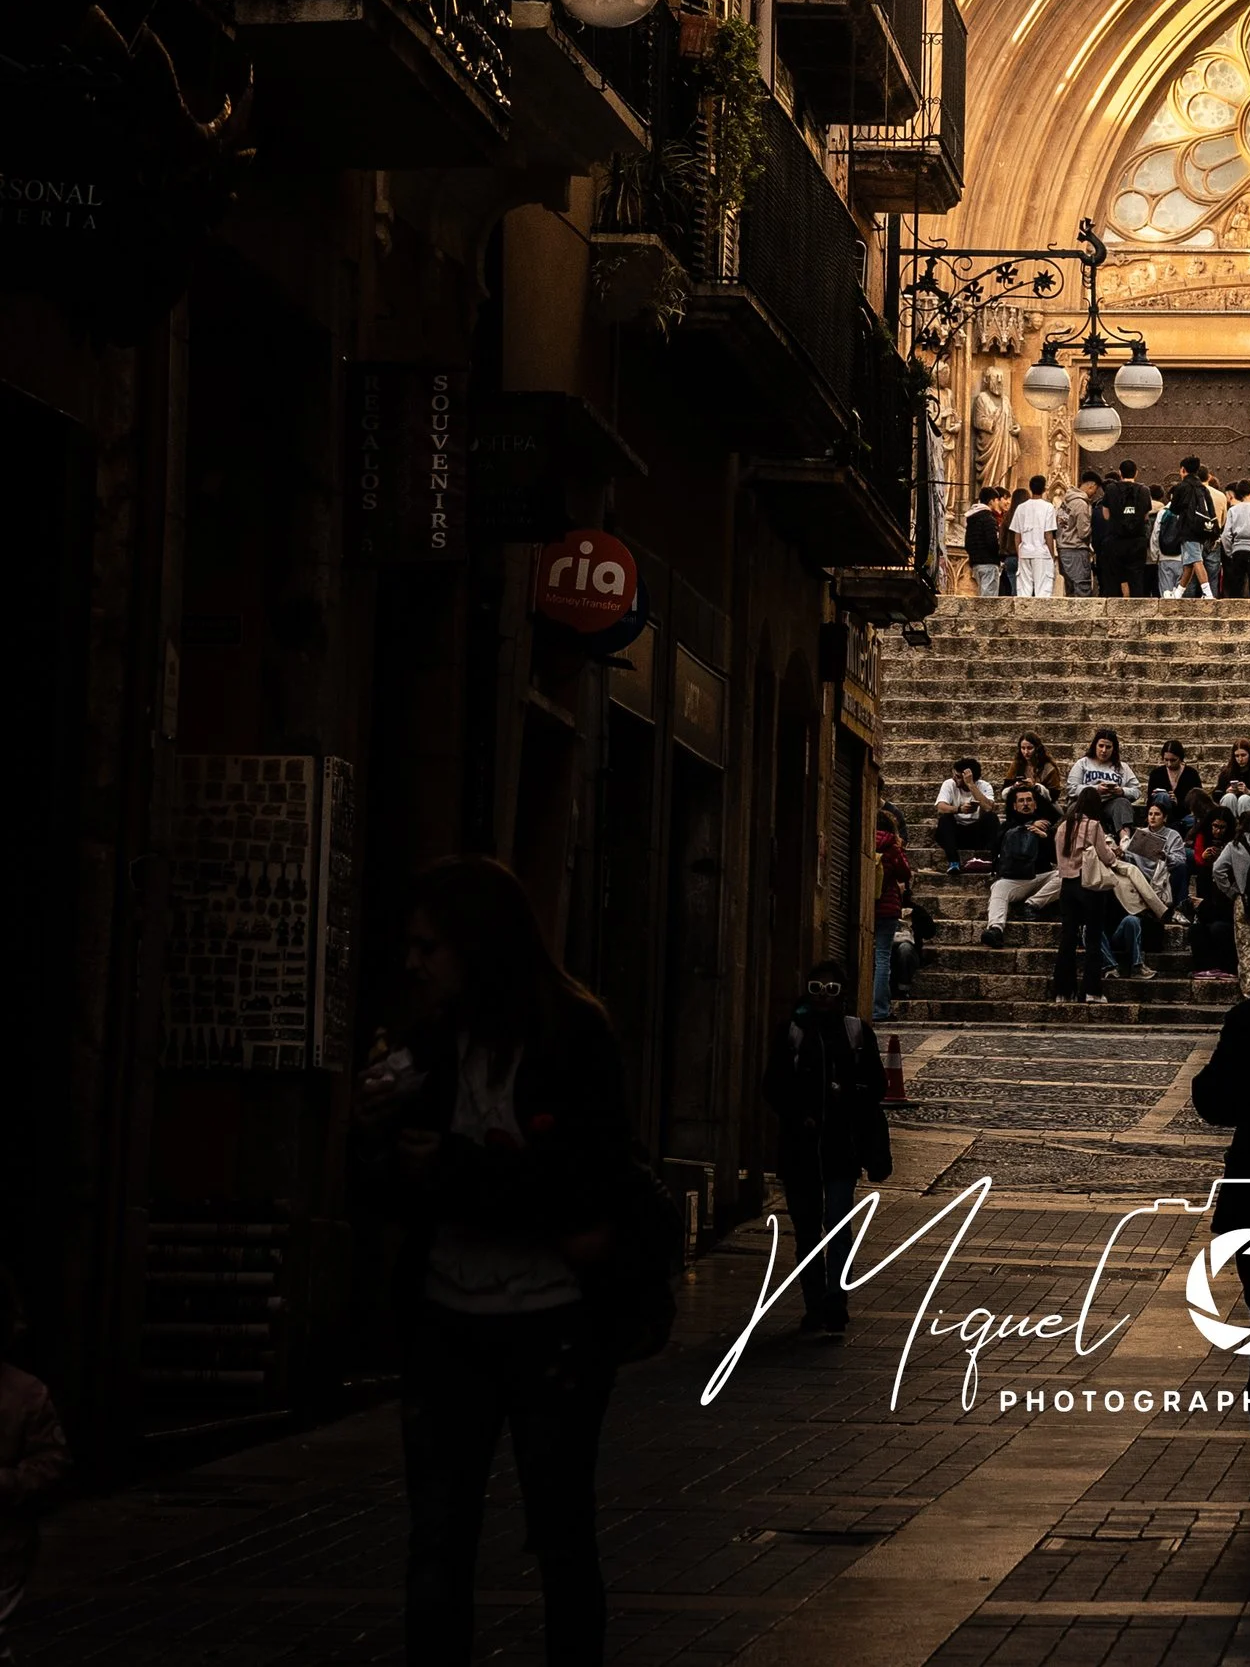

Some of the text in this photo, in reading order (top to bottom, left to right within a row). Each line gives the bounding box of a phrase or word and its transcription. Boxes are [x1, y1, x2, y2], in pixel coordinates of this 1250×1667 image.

[359, 374, 381, 511] REGALOS
[429, 374, 450, 550] SOUVENIRS
[548, 540, 626, 596] ria
[545, 592, 622, 612] Money Transfer
[1085, 770, 1123, 787] MONACO
